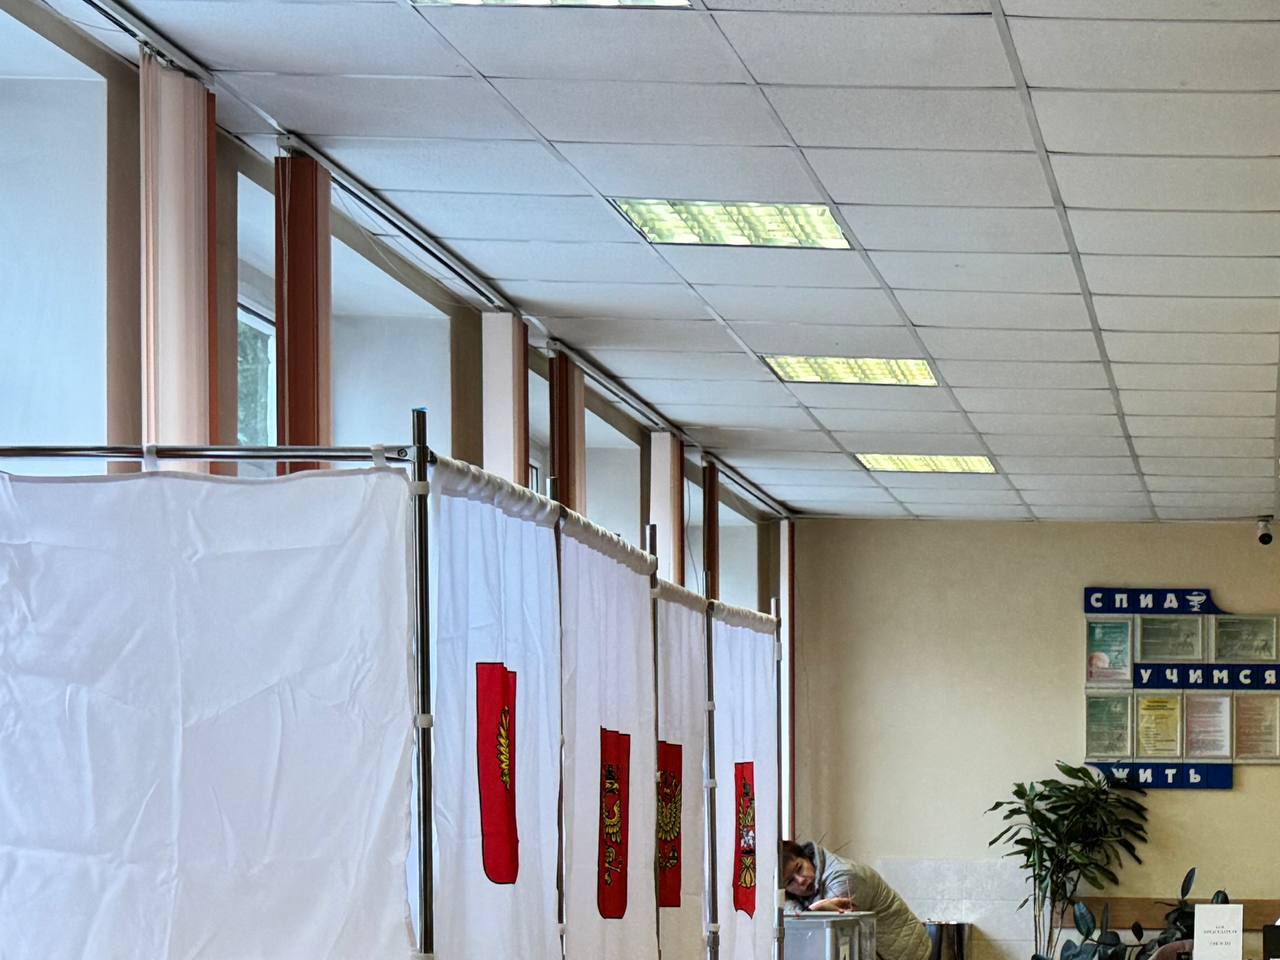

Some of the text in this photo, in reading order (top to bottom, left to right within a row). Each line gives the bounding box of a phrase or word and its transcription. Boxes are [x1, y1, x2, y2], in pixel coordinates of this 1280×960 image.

[1090, 592, 1179, 609] СПИД
[1140, 668, 1277, 685] УЧИМСЯ
[1111, 767, 1202, 783] ЖИТЬ
